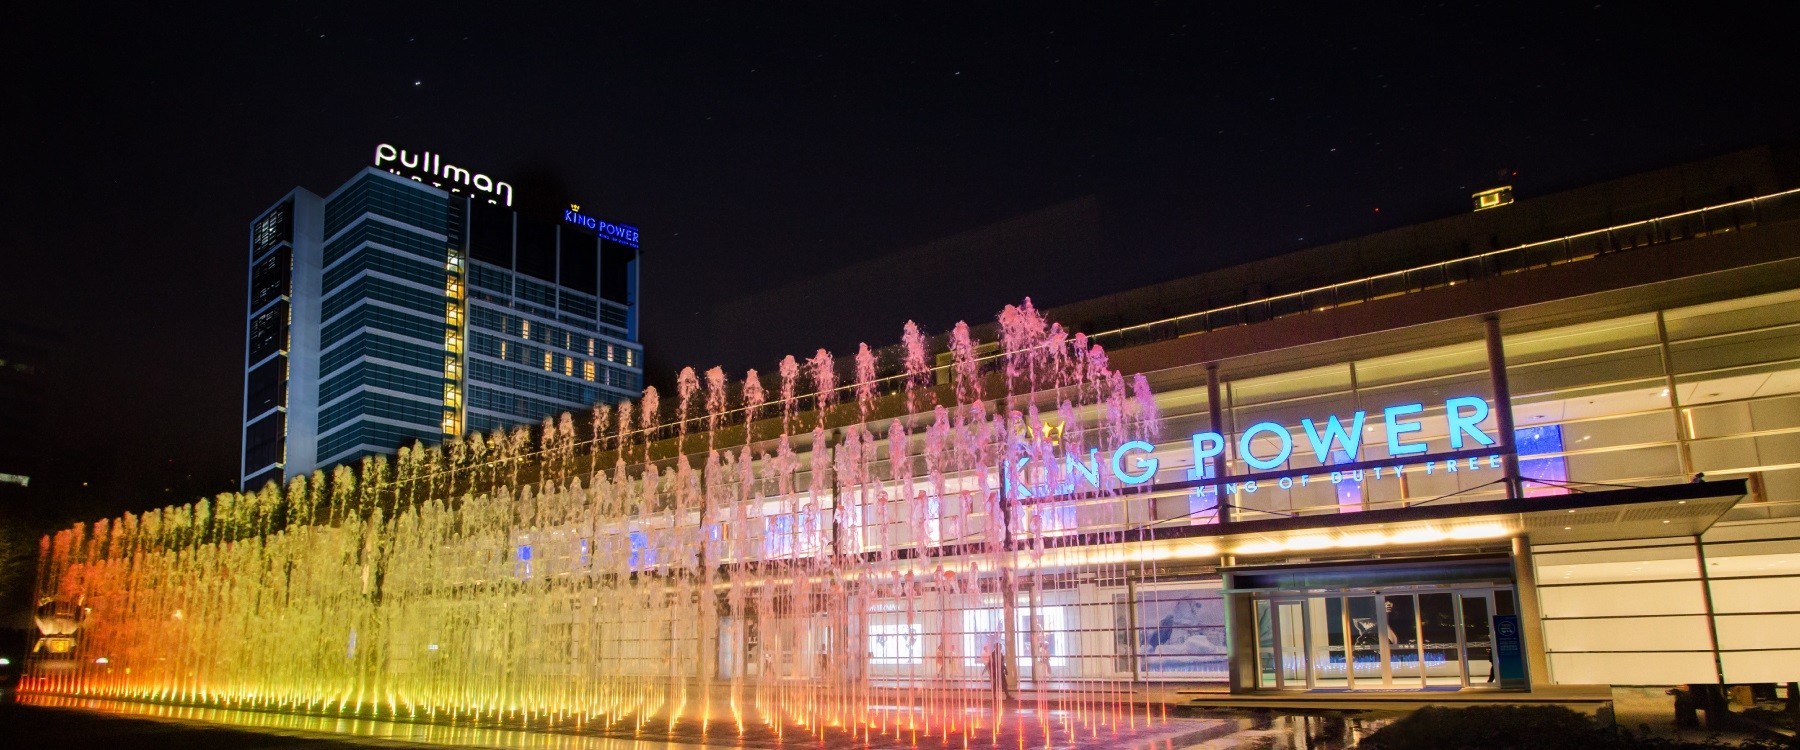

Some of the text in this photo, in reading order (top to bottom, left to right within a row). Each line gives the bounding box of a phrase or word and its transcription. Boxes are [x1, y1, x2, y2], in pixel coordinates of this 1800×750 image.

[375, 143, 513, 207] pullman
[565, 209, 596, 229] KING
[599, 221, 639, 243] POWER
[1191, 395, 1496, 478] POWER
[1196, 454, 1501, 498] KING OF DUTY FREE
